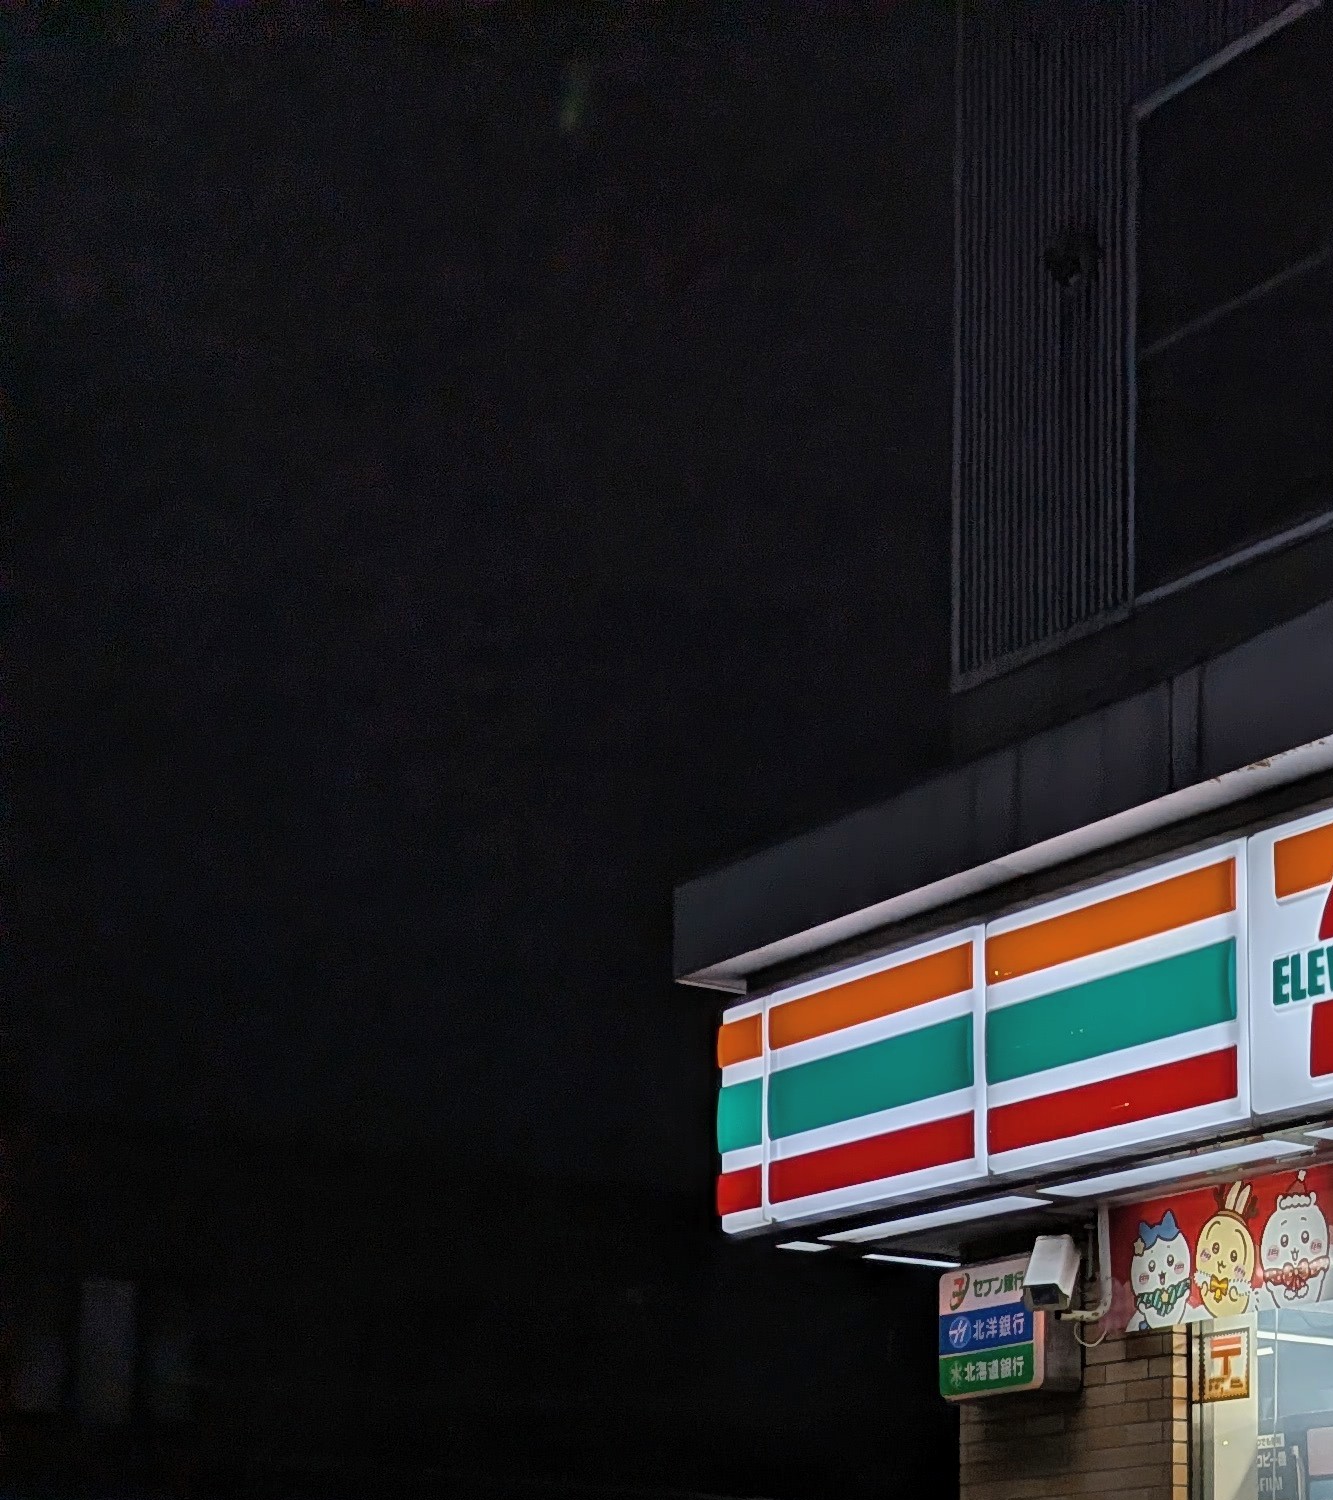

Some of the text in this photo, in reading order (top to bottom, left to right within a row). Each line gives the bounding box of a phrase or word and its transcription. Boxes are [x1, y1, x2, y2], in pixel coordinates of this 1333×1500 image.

[973, 1312, 1025, 1341] 北洋銀行
[965, 1356, 1025, 1382] 北海道銀行
